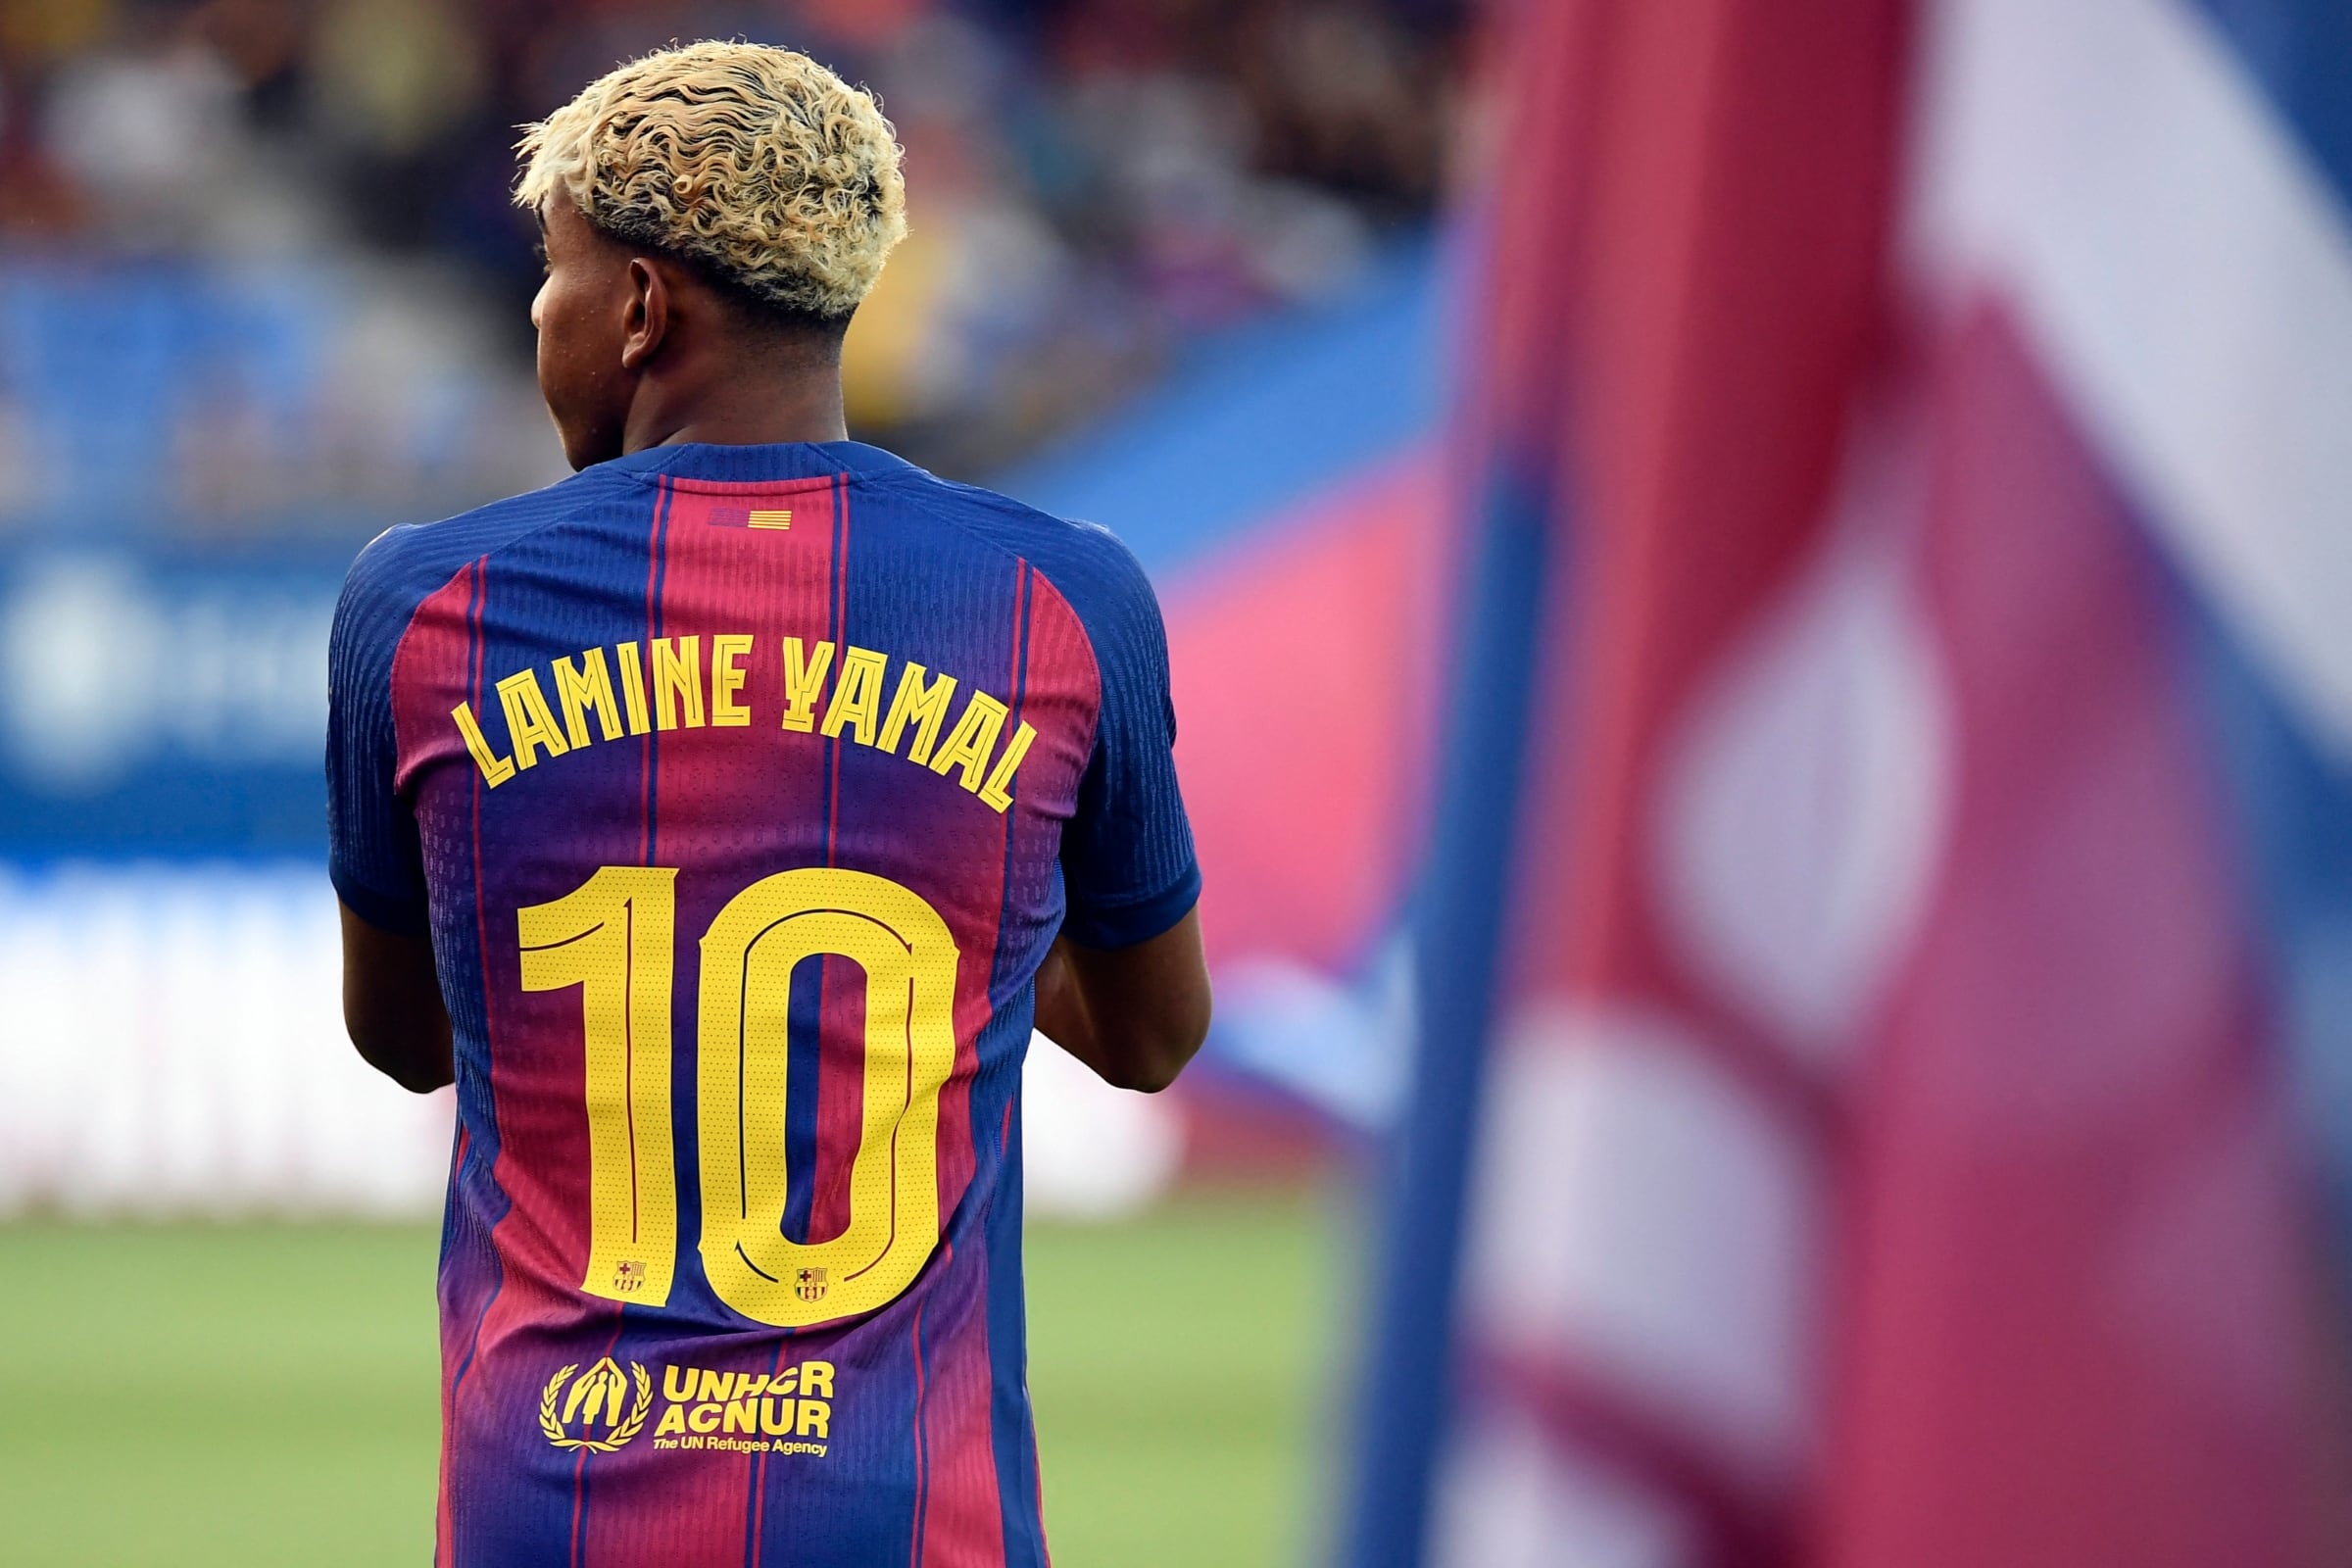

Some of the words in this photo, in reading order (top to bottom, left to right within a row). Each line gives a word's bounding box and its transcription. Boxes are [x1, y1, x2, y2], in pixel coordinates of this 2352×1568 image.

[451, 634, 754, 789] LAMINE
[782, 636, 1037, 814] YAMAL
[517, 866, 959, 1327] 10
[662, 1361, 835, 1402] UNHCR
[654, 1398, 831, 1439] ACNUR
[654, 1438, 678, 1449] The
[680, 1436, 704, 1450] UN
[707, 1436, 769, 1453] Refugee
[772, 1439, 827, 1457] Agency
